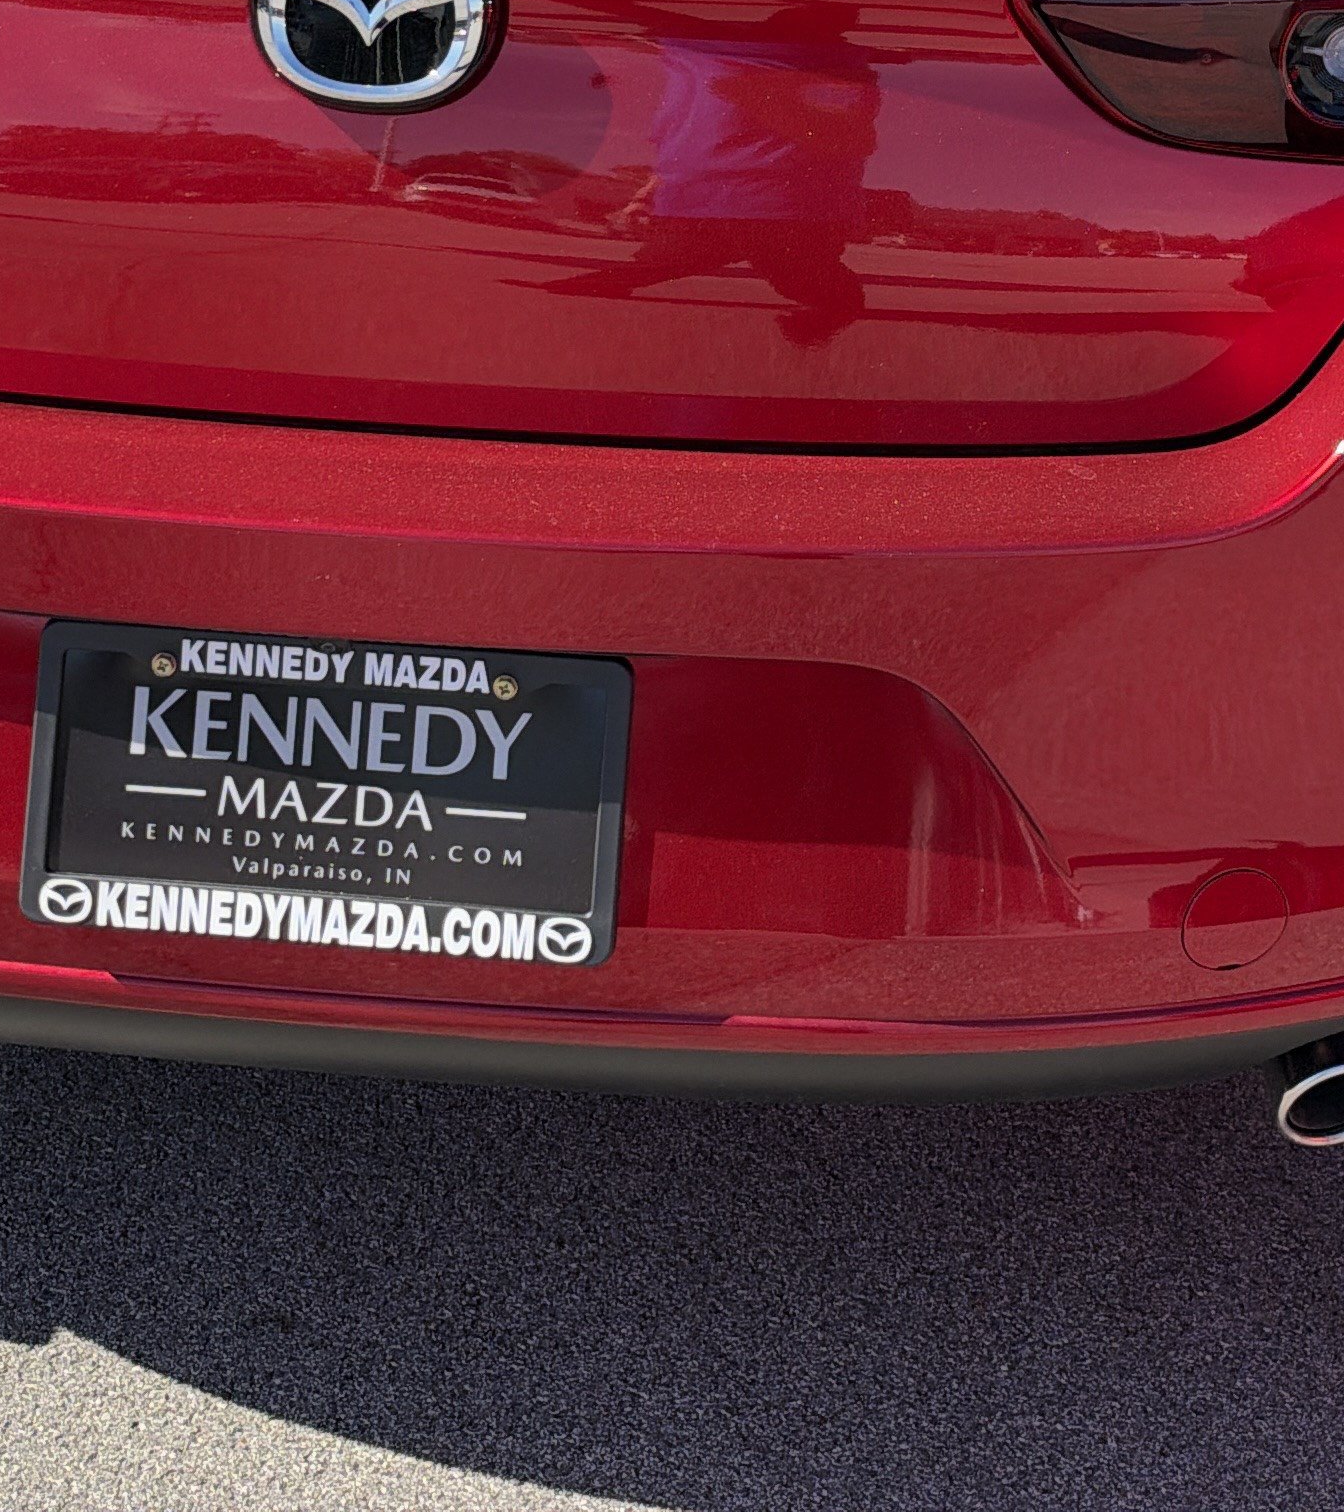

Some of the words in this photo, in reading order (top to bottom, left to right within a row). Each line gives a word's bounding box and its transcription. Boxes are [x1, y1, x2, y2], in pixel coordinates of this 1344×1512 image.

[180, 639, 354, 684] KENNEDY
[364, 651, 491, 696] MAZDA
[129, 685, 533, 781] KENNEDY
[216, 775, 434, 832] MAZDA
[121, 821, 524, 868] KENNEDYMAZDA.COM
[232, 855, 372, 885] Valparaiso,
[385, 866, 411, 886] IN
[96, 881, 537, 961] KENNEDYMAZDA.COM
